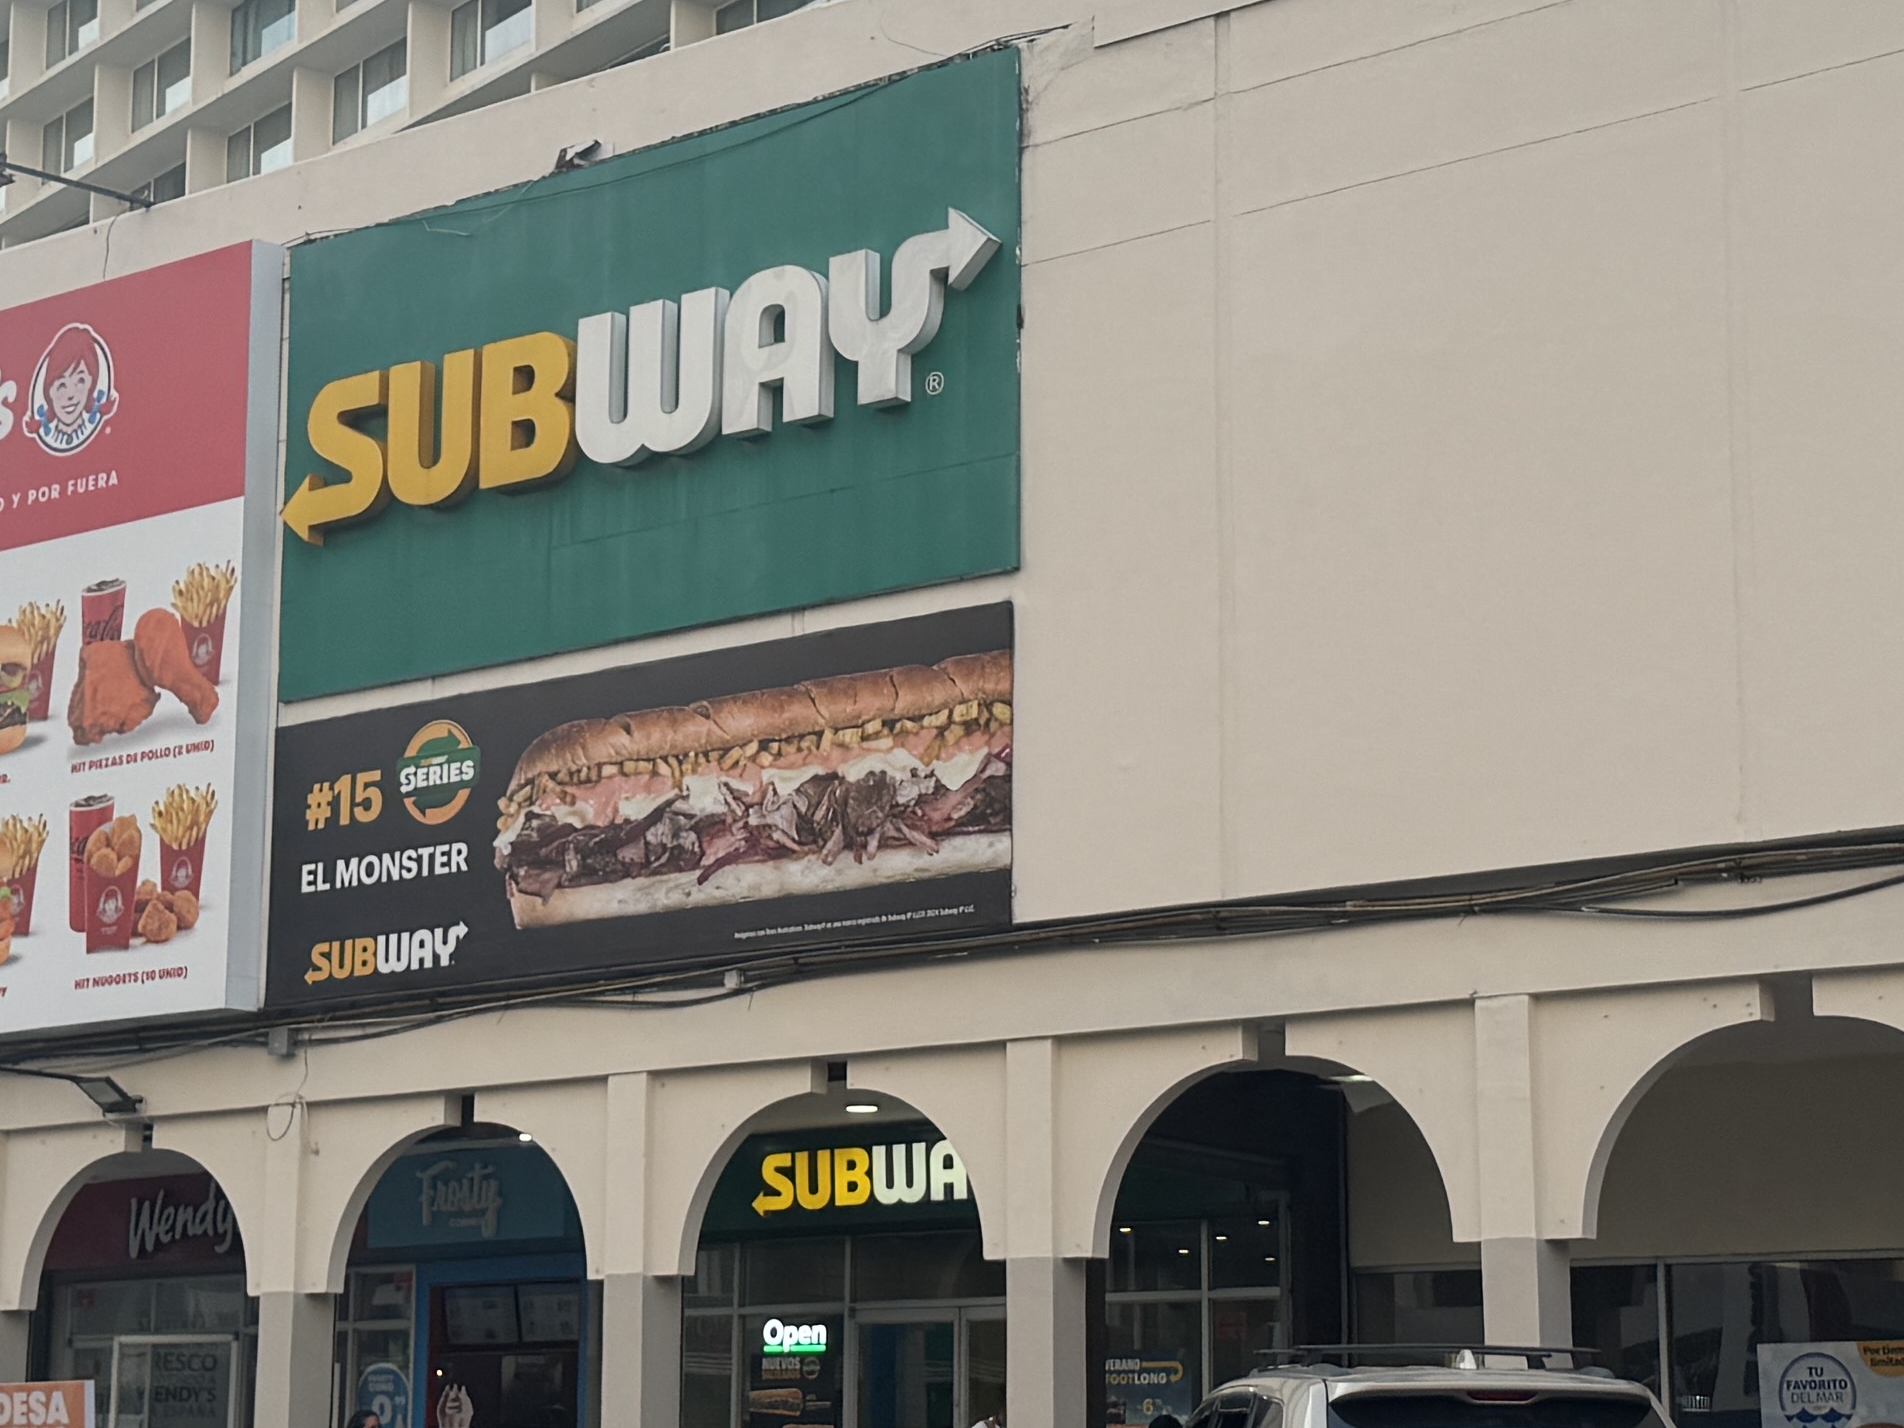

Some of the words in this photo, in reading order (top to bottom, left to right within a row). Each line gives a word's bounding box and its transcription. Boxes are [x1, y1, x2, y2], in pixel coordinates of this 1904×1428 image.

[280, 207, 1001, 545] SUBWAY
[12, 492, 22, 509] Y
[27, 484, 60, 505] POR
[67, 470, 119, 496] FUERA
[71, 761, 87, 774] HIT
[88, 756, 124, 771] PIEZAS
[126, 753, 139, 765] DE
[140, 748, 171, 763] POLLO
[400, 760, 475, 794] SERIES
[306, 769, 383, 831] #15
[301, 862, 330, 893] EL
[335, 842, 469, 889] MONSTER
[304, 921, 469, 985] SUBWAY
[74, 977, 90, 990] HIT
[92, 971, 139, 988] NUGGETS
[416, 1159, 503, 1238] Frosty
[751, 1139, 968, 1217] SUBWA
[129, 1177, 236, 1260] Wendy
[762, 1318, 827, 1353] Open
[1786, 1378, 1848, 1392] FAVORITO
[1807, 1366, 1824, 1378] TU
